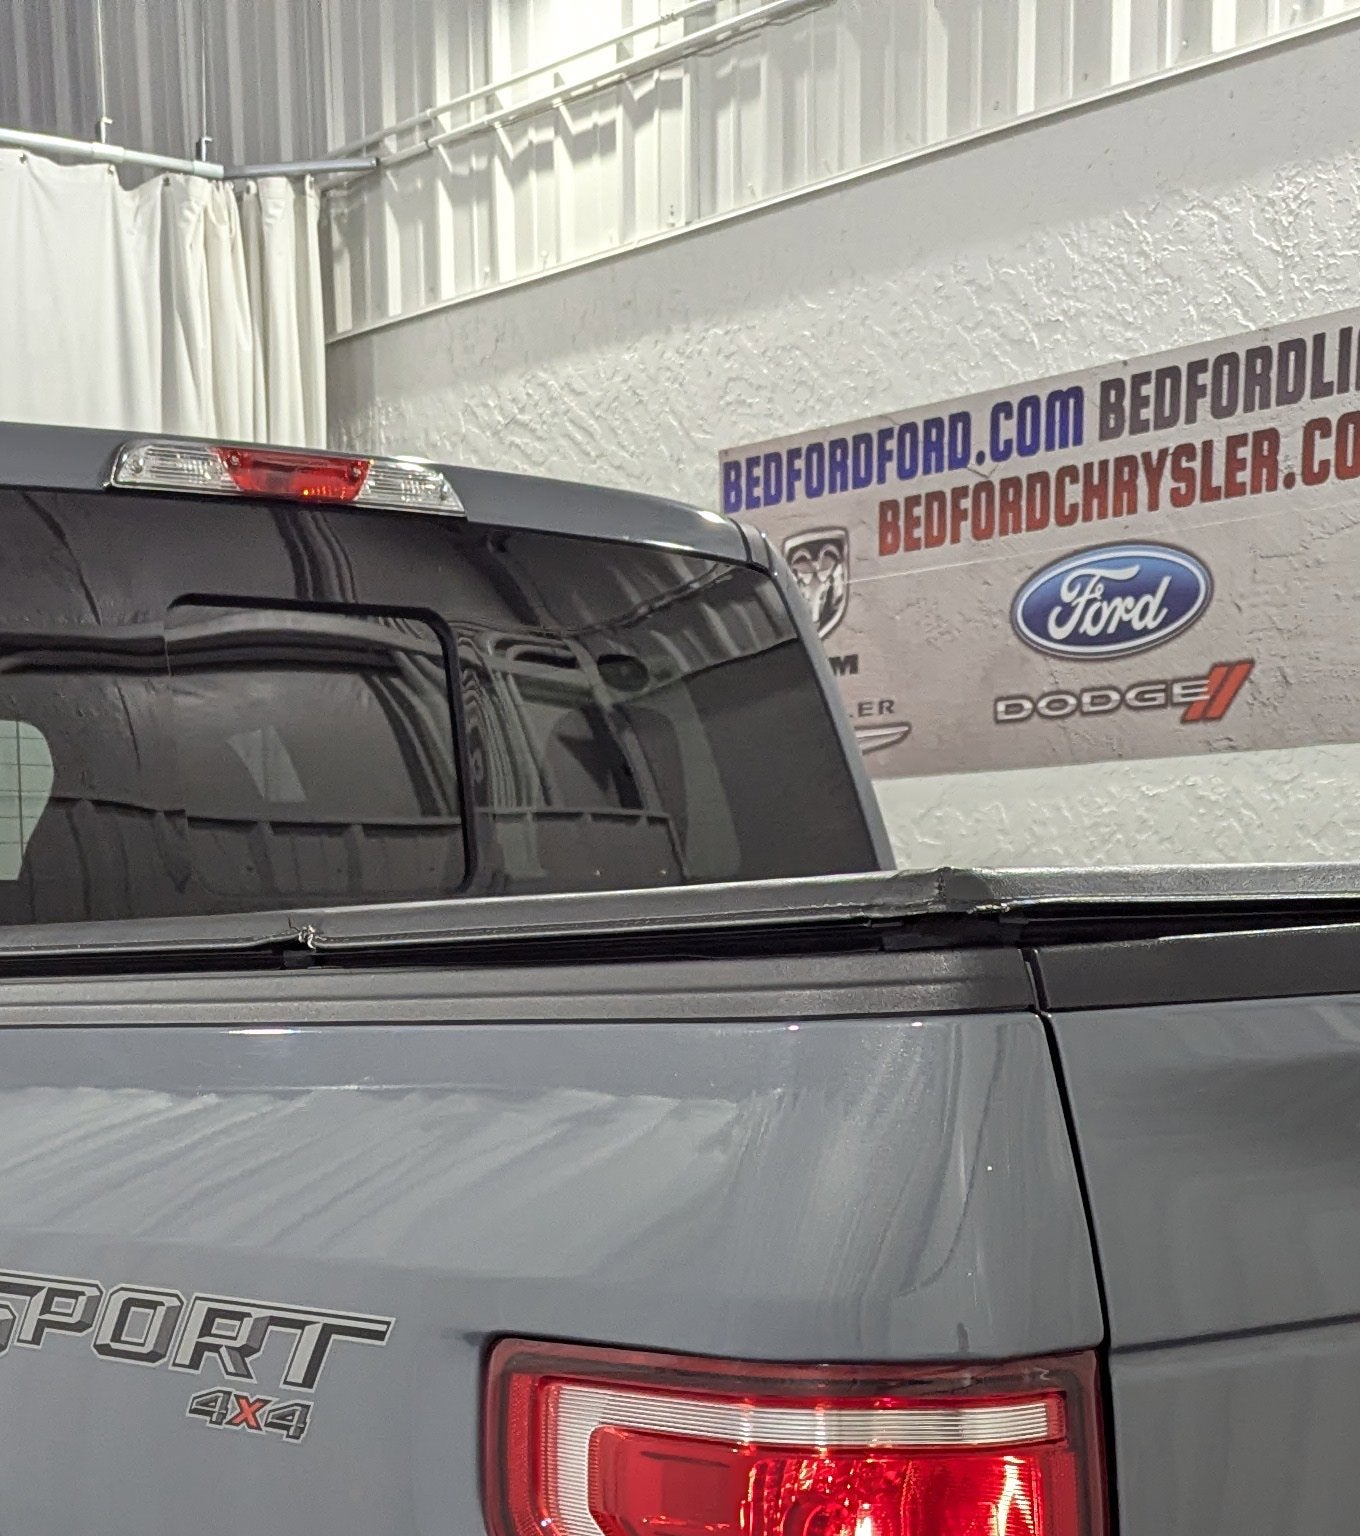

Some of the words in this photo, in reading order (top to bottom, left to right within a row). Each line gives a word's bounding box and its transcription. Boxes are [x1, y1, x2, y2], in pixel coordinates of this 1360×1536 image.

[723, 385, 1084, 514] BEDFORDFORD.COM
[1047, 563, 1172, 640] Ford
[993, 675, 1212, 724] DODGE
